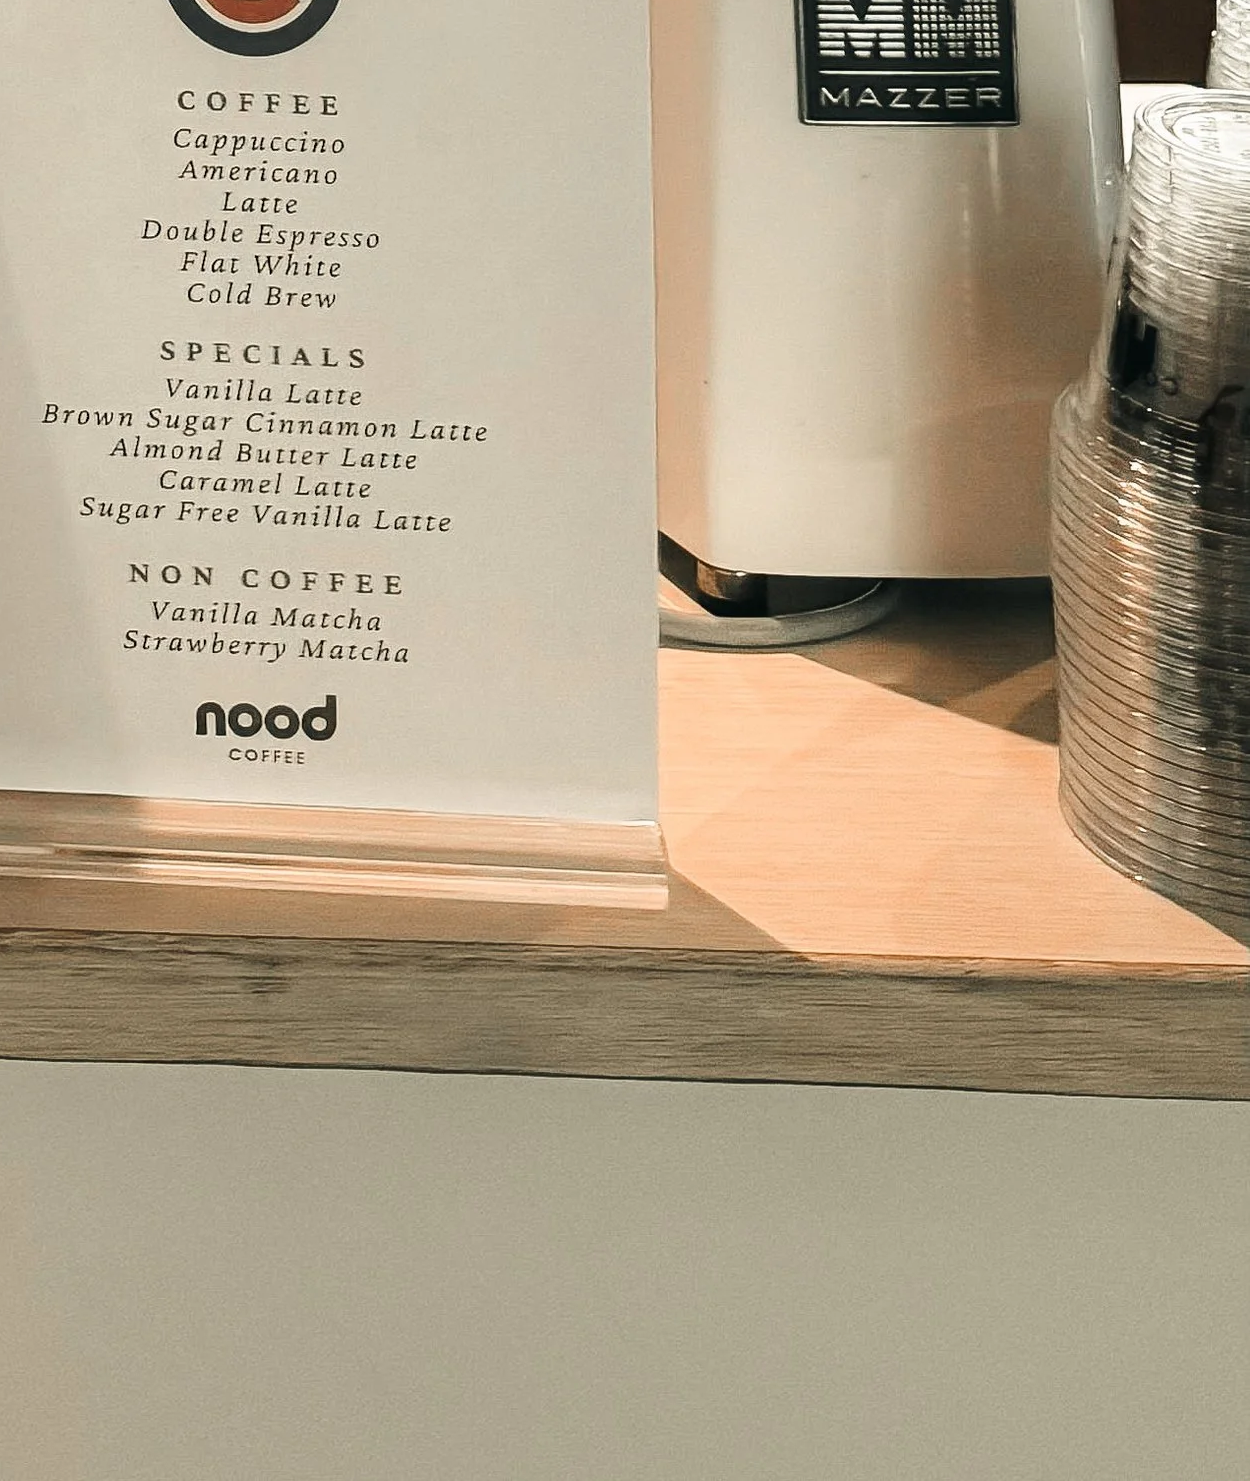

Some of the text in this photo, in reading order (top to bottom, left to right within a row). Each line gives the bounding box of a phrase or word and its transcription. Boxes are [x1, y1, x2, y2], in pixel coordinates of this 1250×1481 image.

[177, 90, 338, 116] COFFEE
[819, 87, 1004, 110] MAZZER
[173, 128, 345, 157] Cappuccino
[177, 159, 338, 185] Americano
[221, 191, 298, 215] Latte
[140, 219, 380, 253] Double Espresso
[179, 249, 341, 278] Flat White
[187, 281, 336, 309] Cold Brew
[159, 340, 365, 369] SPECIALS
[166, 378, 362, 406] Vanilla Latte
[41, 403, 488, 442] Brown Sugar Cinnamon Latte
[108, 435, 417, 470] Almond Butter Latte
[159, 469, 372, 499] Caramel Latte
[79, 496, 451, 533] Sugar Free Vanilla Latte
[128, 563, 402, 596] NON COFFEE
[151, 600, 381, 632] Vanilla Matcha
[123, 629, 409, 664] Strawberry Matcha
[195, 694, 338, 742] nood
[227, 747, 305, 765] COFFEE
